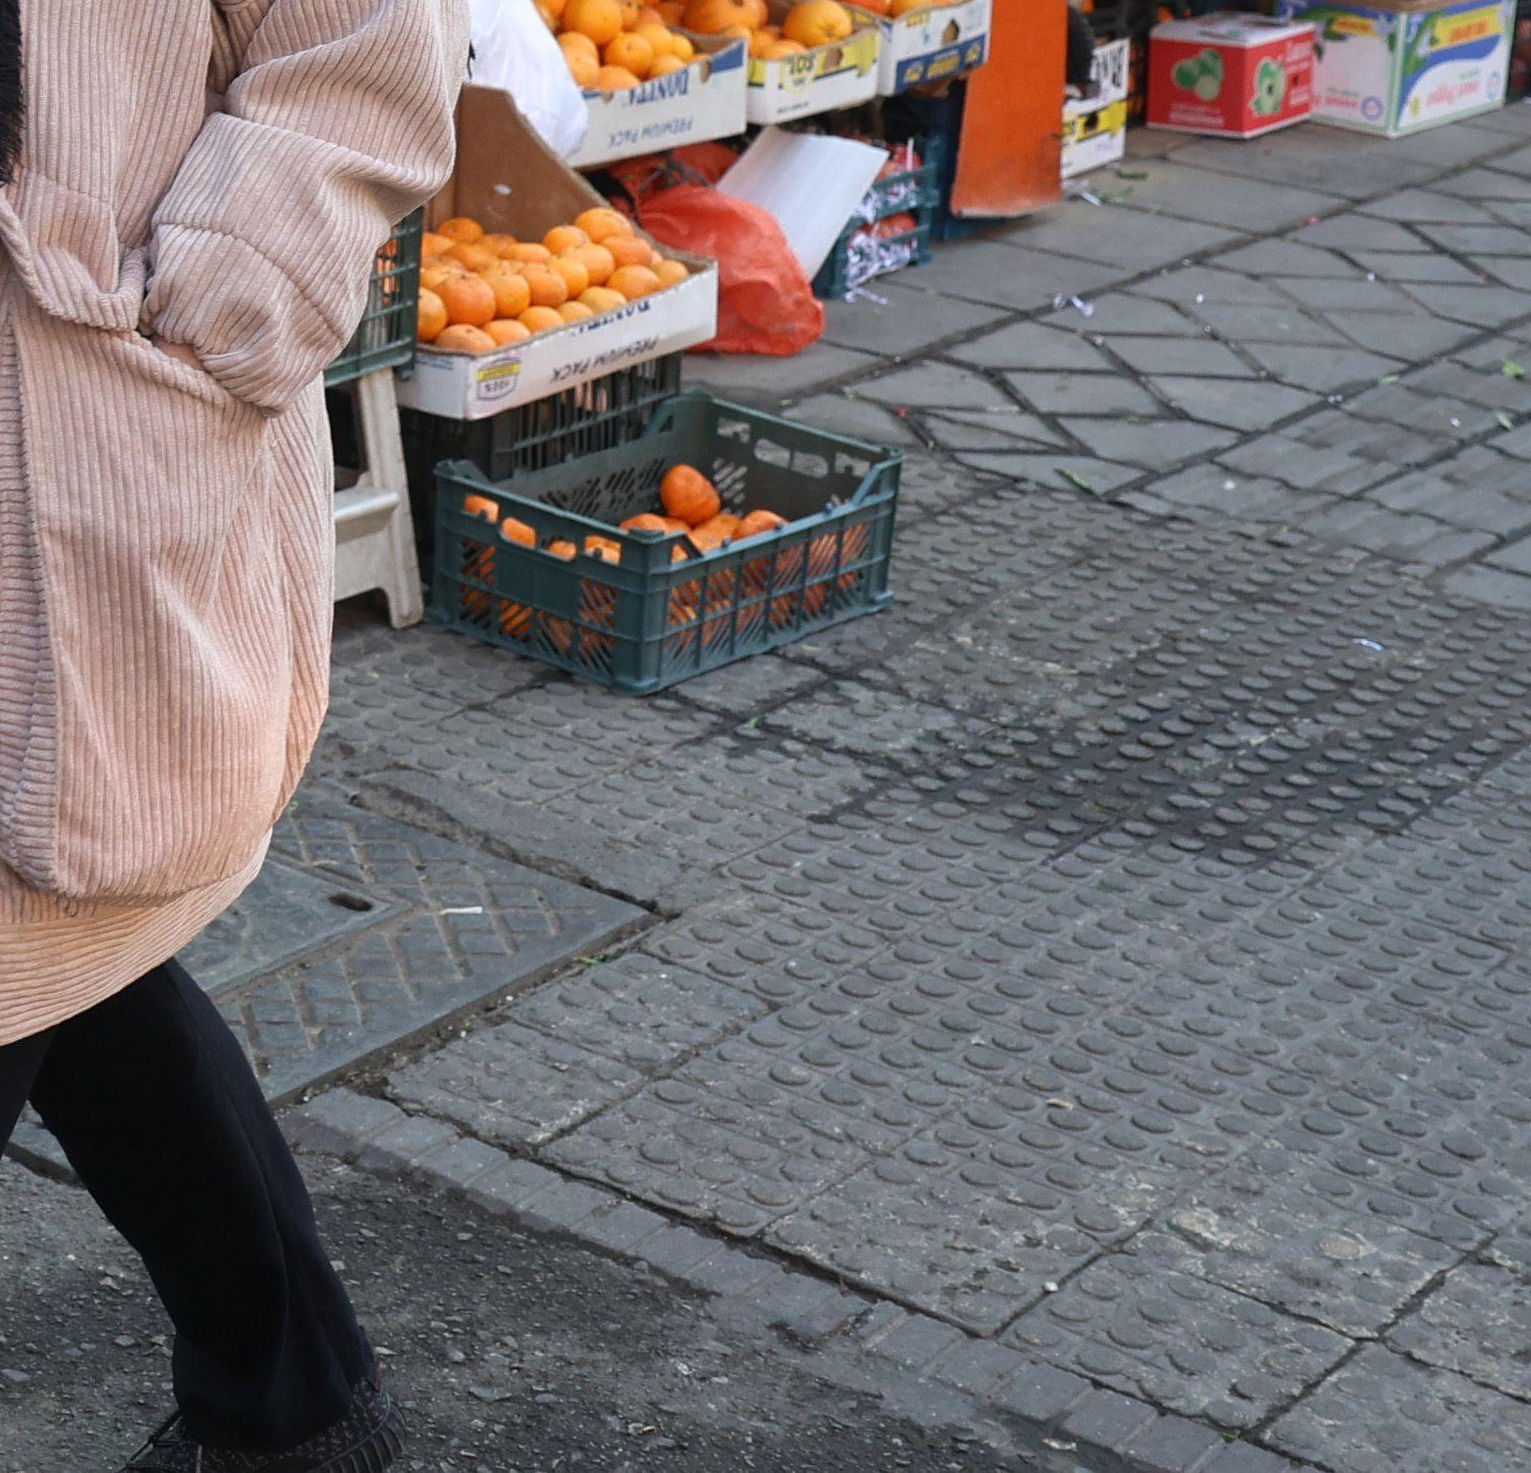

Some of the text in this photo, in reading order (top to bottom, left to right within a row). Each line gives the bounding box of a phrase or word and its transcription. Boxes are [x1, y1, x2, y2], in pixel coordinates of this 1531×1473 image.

[607, 115, 693, 148] PREMIUM PACK
[549, 336, 659, 384] PREMIUM PACK
